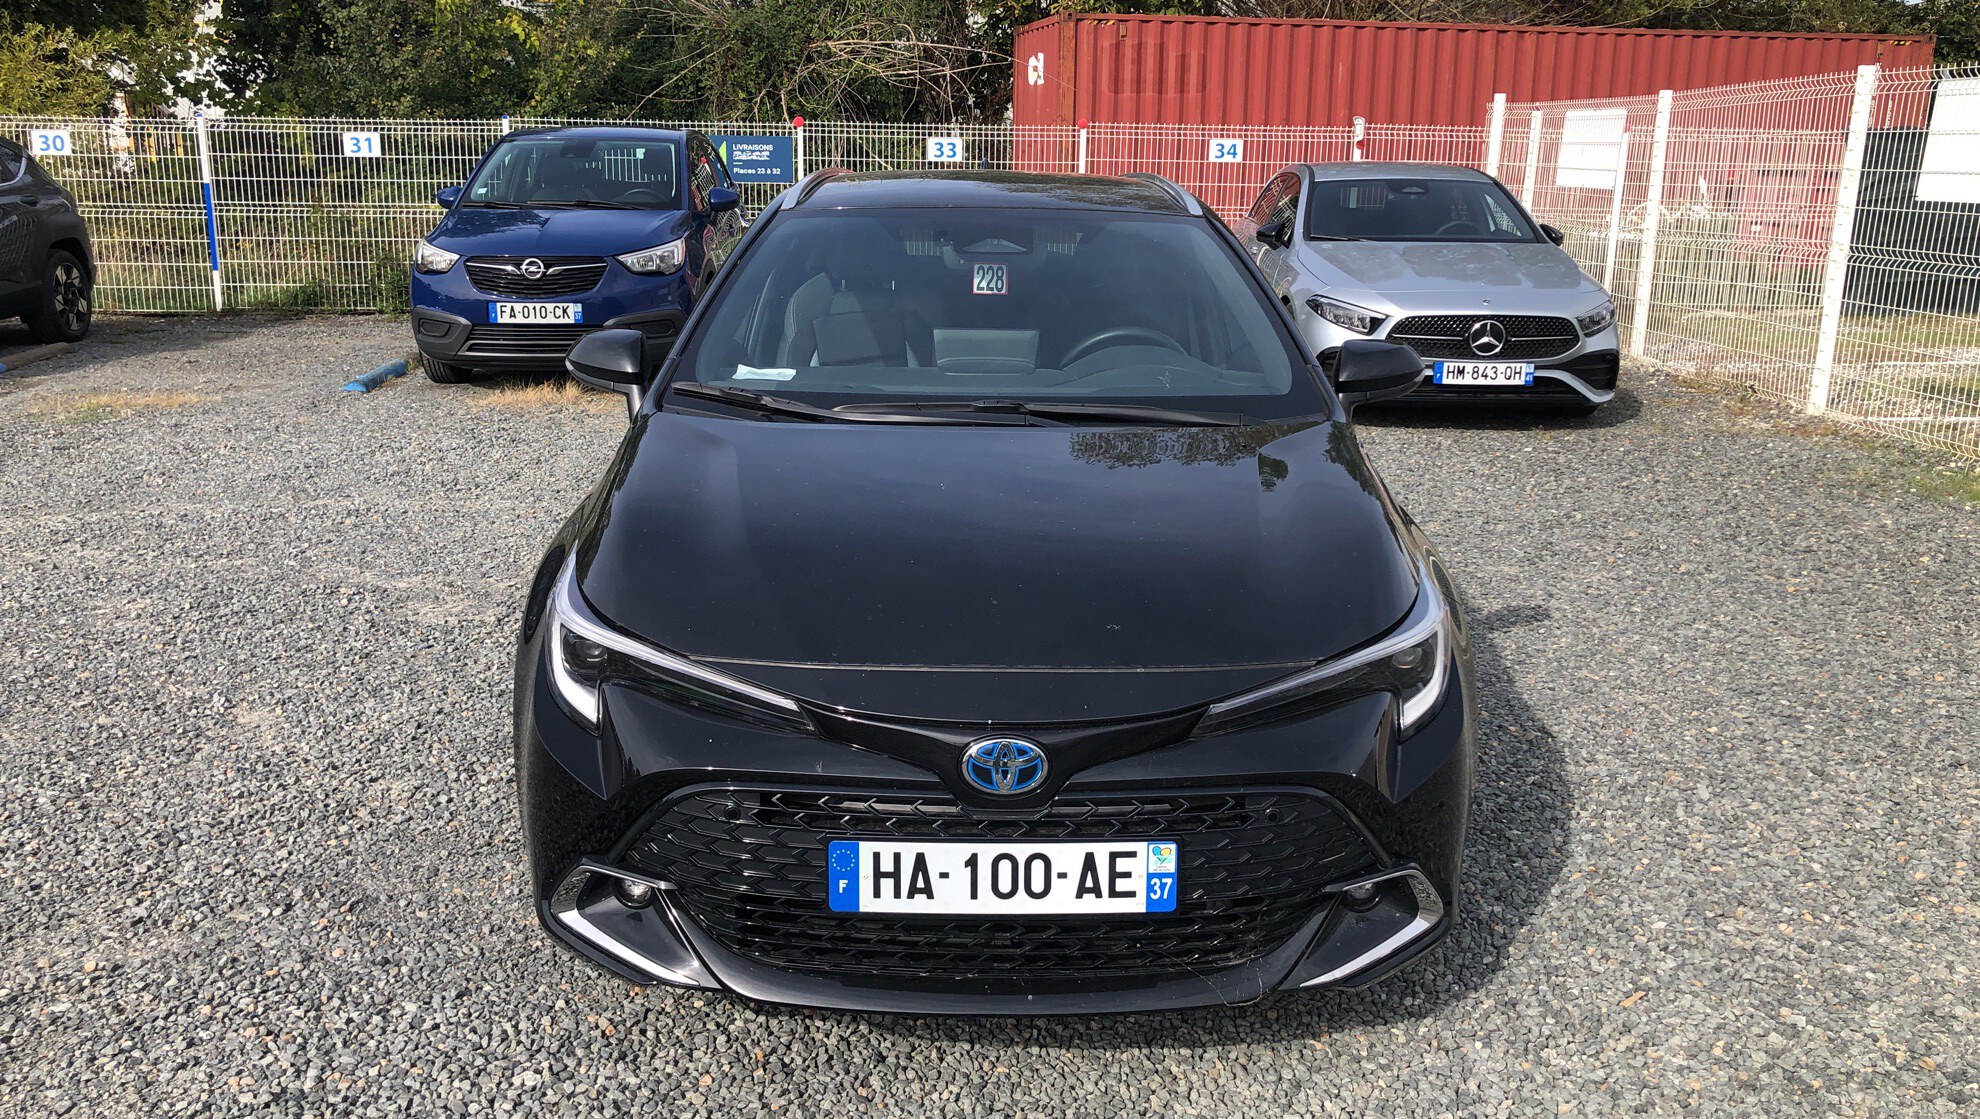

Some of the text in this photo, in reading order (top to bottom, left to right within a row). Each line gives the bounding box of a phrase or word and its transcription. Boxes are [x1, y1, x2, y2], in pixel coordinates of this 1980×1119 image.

[39, 135, 65, 152] 30
[350, 137, 373, 153] 31
[933, 141, 957, 159] 33
[1214, 143, 1238, 159] 34
[733, 167, 756, 175] Places
[757, 167, 766, 175] 23
[976, 265, 1005, 293] 228
[500, 305, 571, 320] FA-010-CK
[575, 312, 582, 320] 37
[1446, 365, 1523, 381] HM-843-QH
[839, 850, 1173, 900] F HA-100-AE 37
